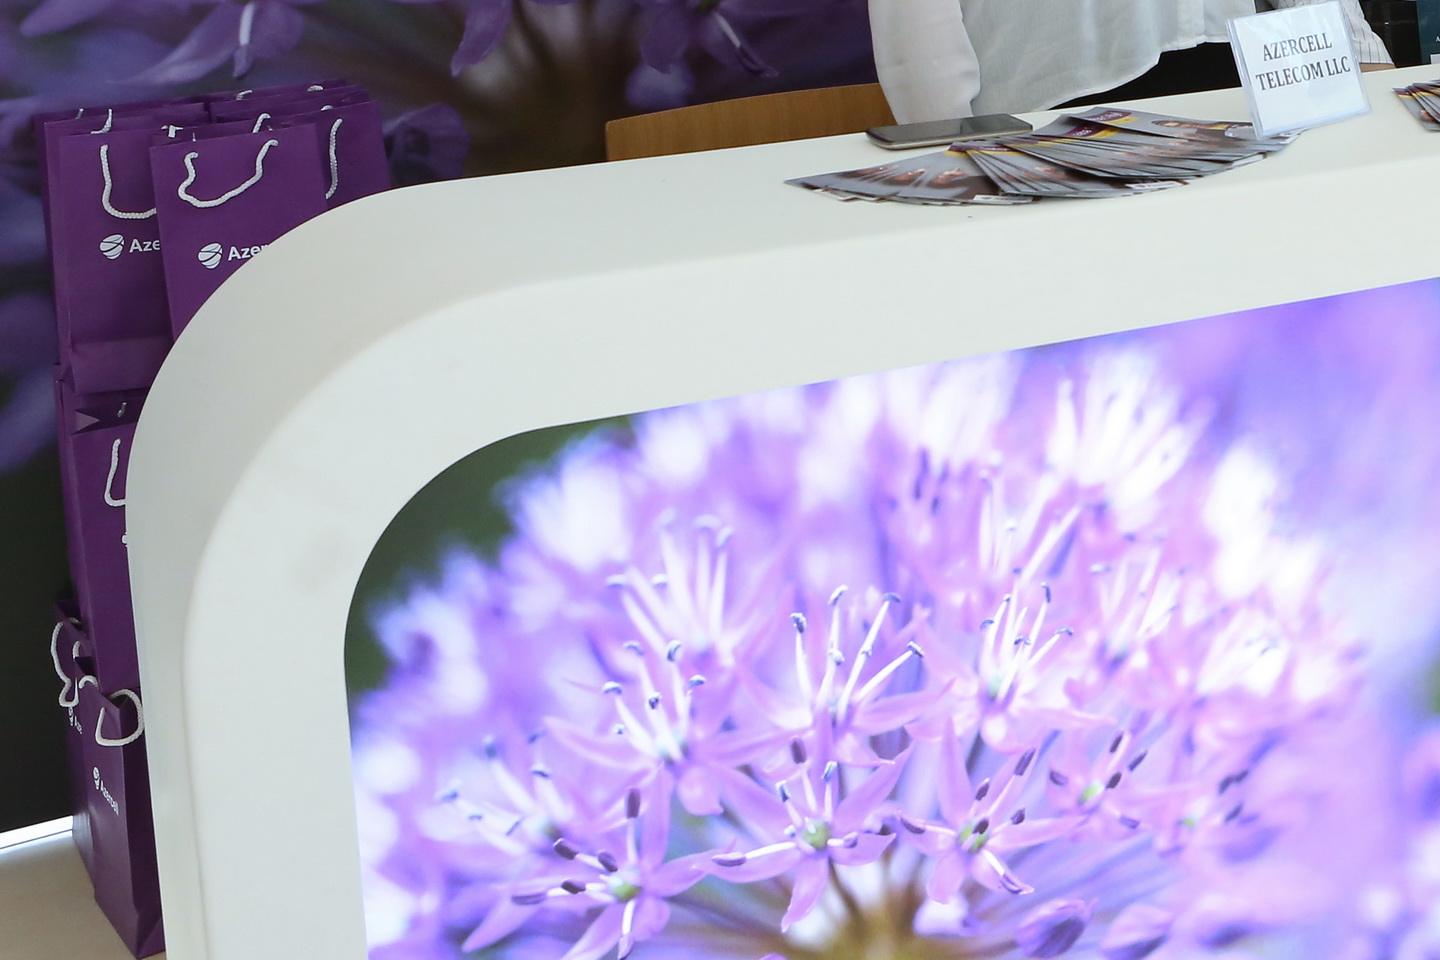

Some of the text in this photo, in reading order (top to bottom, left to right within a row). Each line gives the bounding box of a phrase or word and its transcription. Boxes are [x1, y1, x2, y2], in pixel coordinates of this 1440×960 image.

[1263, 33, 1332, 62] AZERCELL
[1256, 56, 1351, 91] TELECOM LLC
